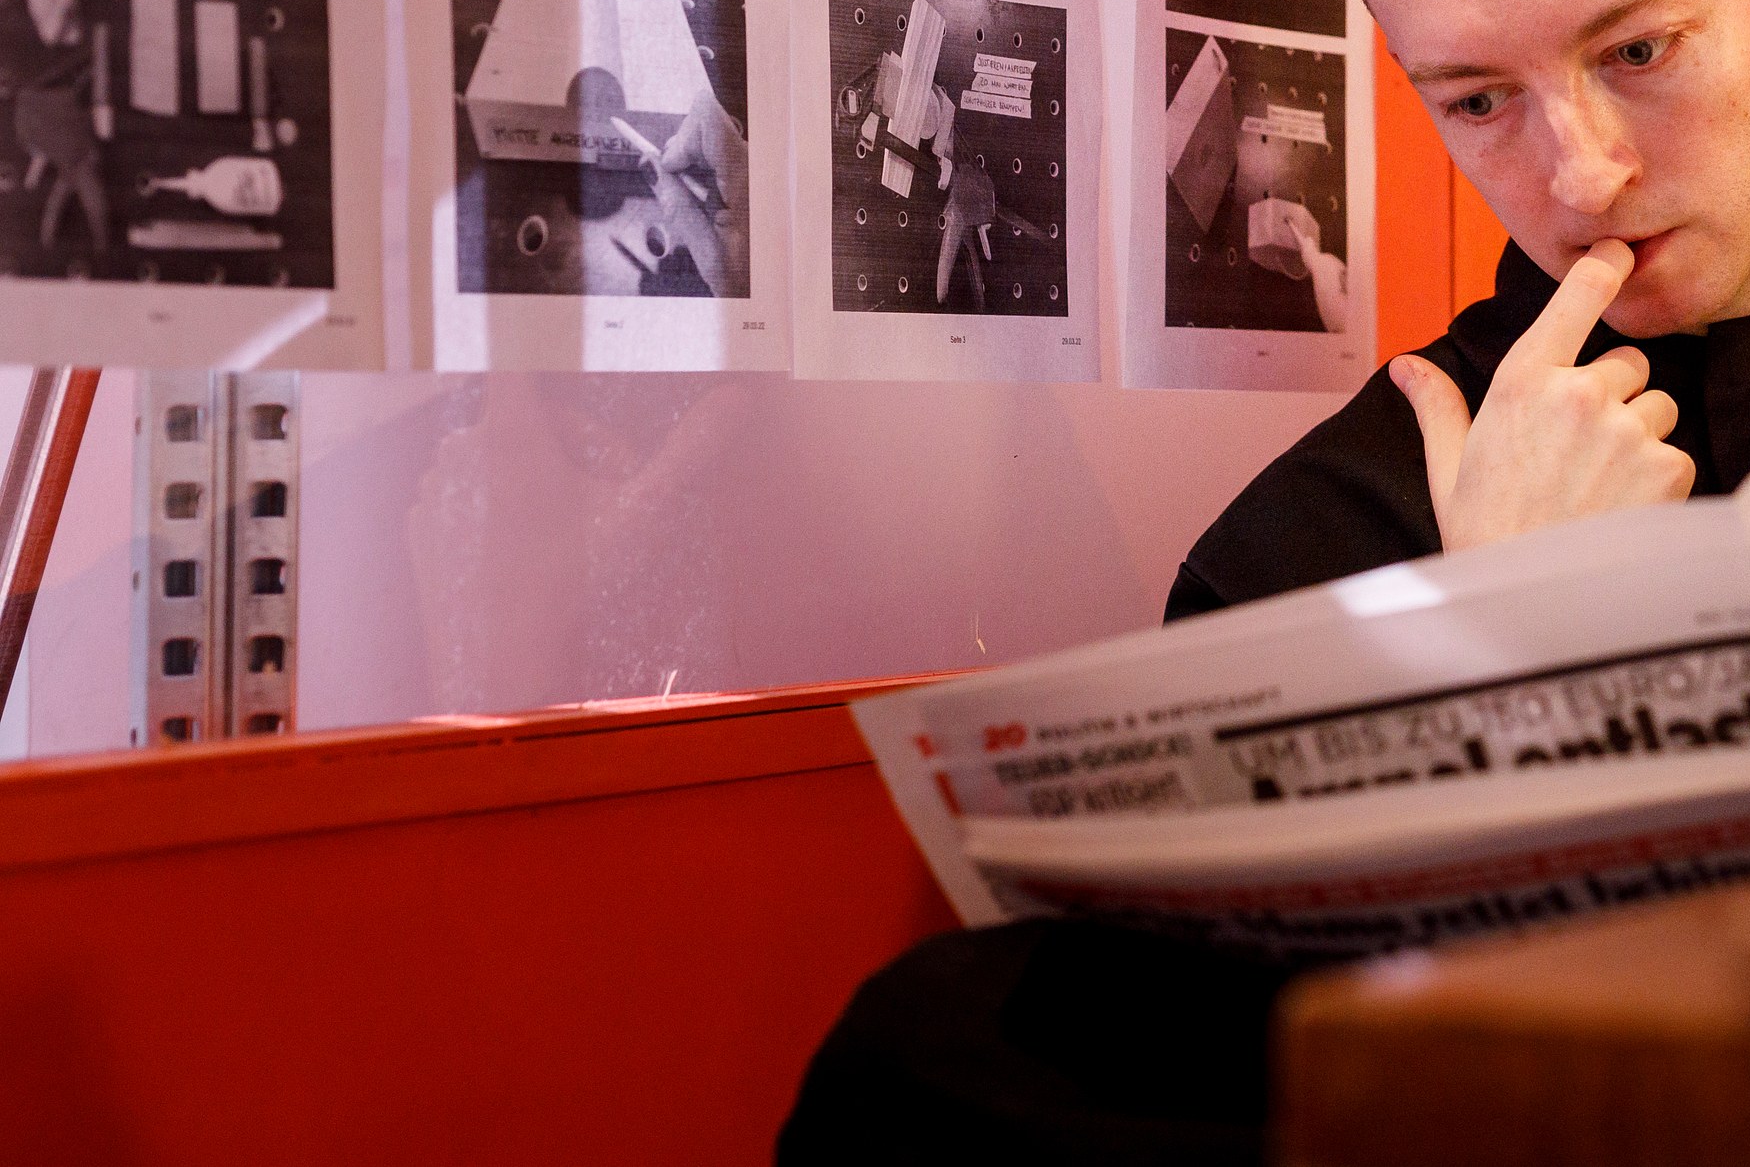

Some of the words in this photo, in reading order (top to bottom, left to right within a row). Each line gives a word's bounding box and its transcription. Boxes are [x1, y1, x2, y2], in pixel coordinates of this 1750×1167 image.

[1061, 337, 1082, 345] 29.03.22
[1314, 715, 1390, 764] BIS
[1403, 702, 1463, 752] ZU
